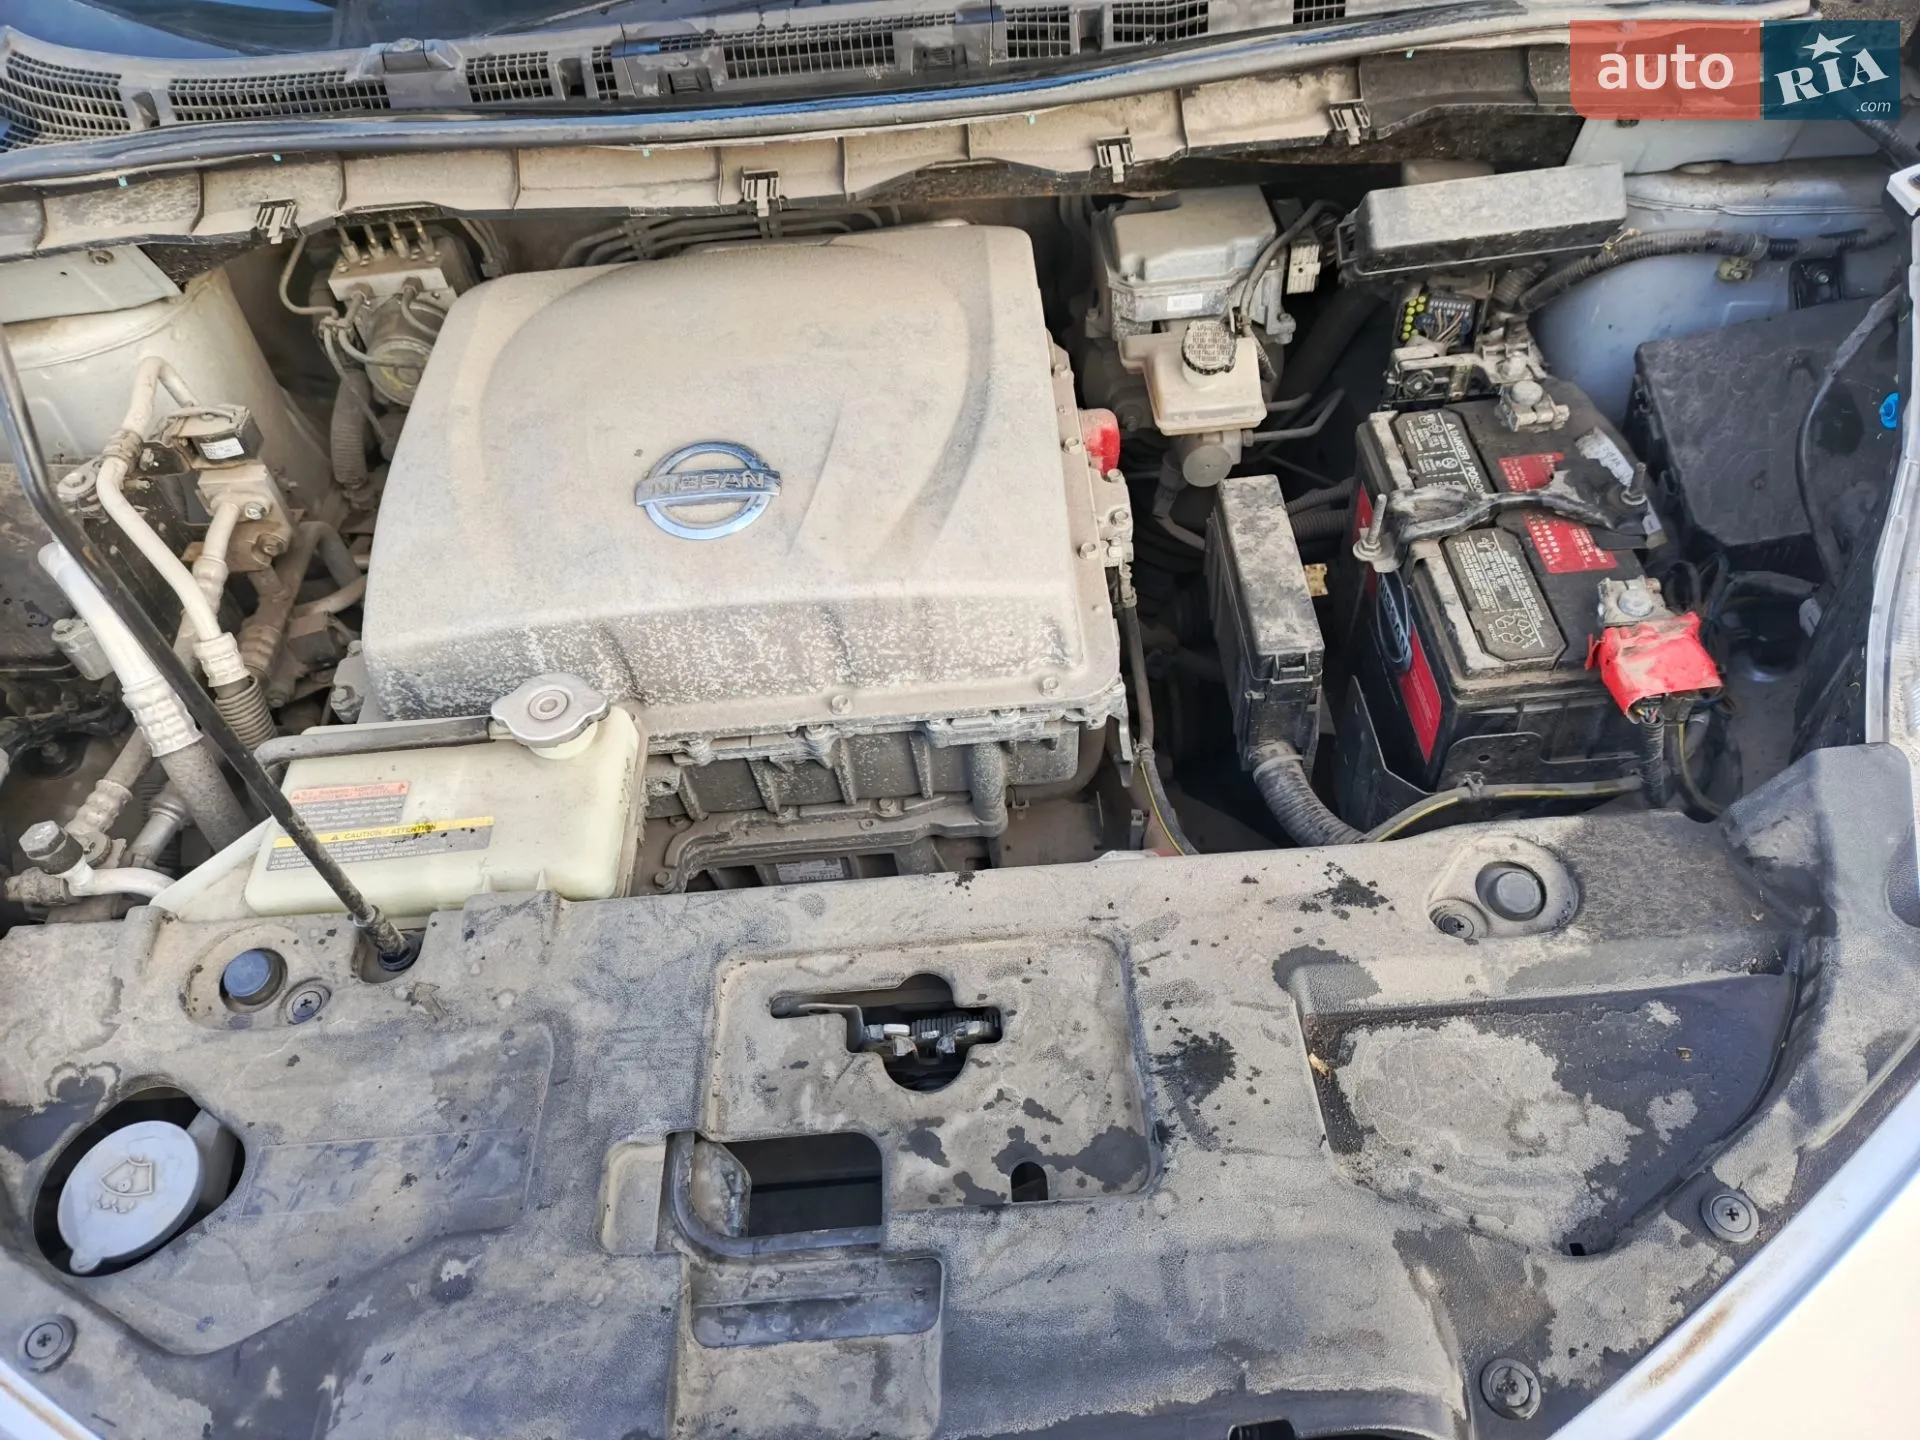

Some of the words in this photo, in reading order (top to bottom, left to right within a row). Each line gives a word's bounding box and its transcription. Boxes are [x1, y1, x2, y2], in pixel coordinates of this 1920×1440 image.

[651, 472, 765, 496] NISSAN
[344, 828, 382, 839] CAUTION
[391, 824, 436, 835] ATTENTION
